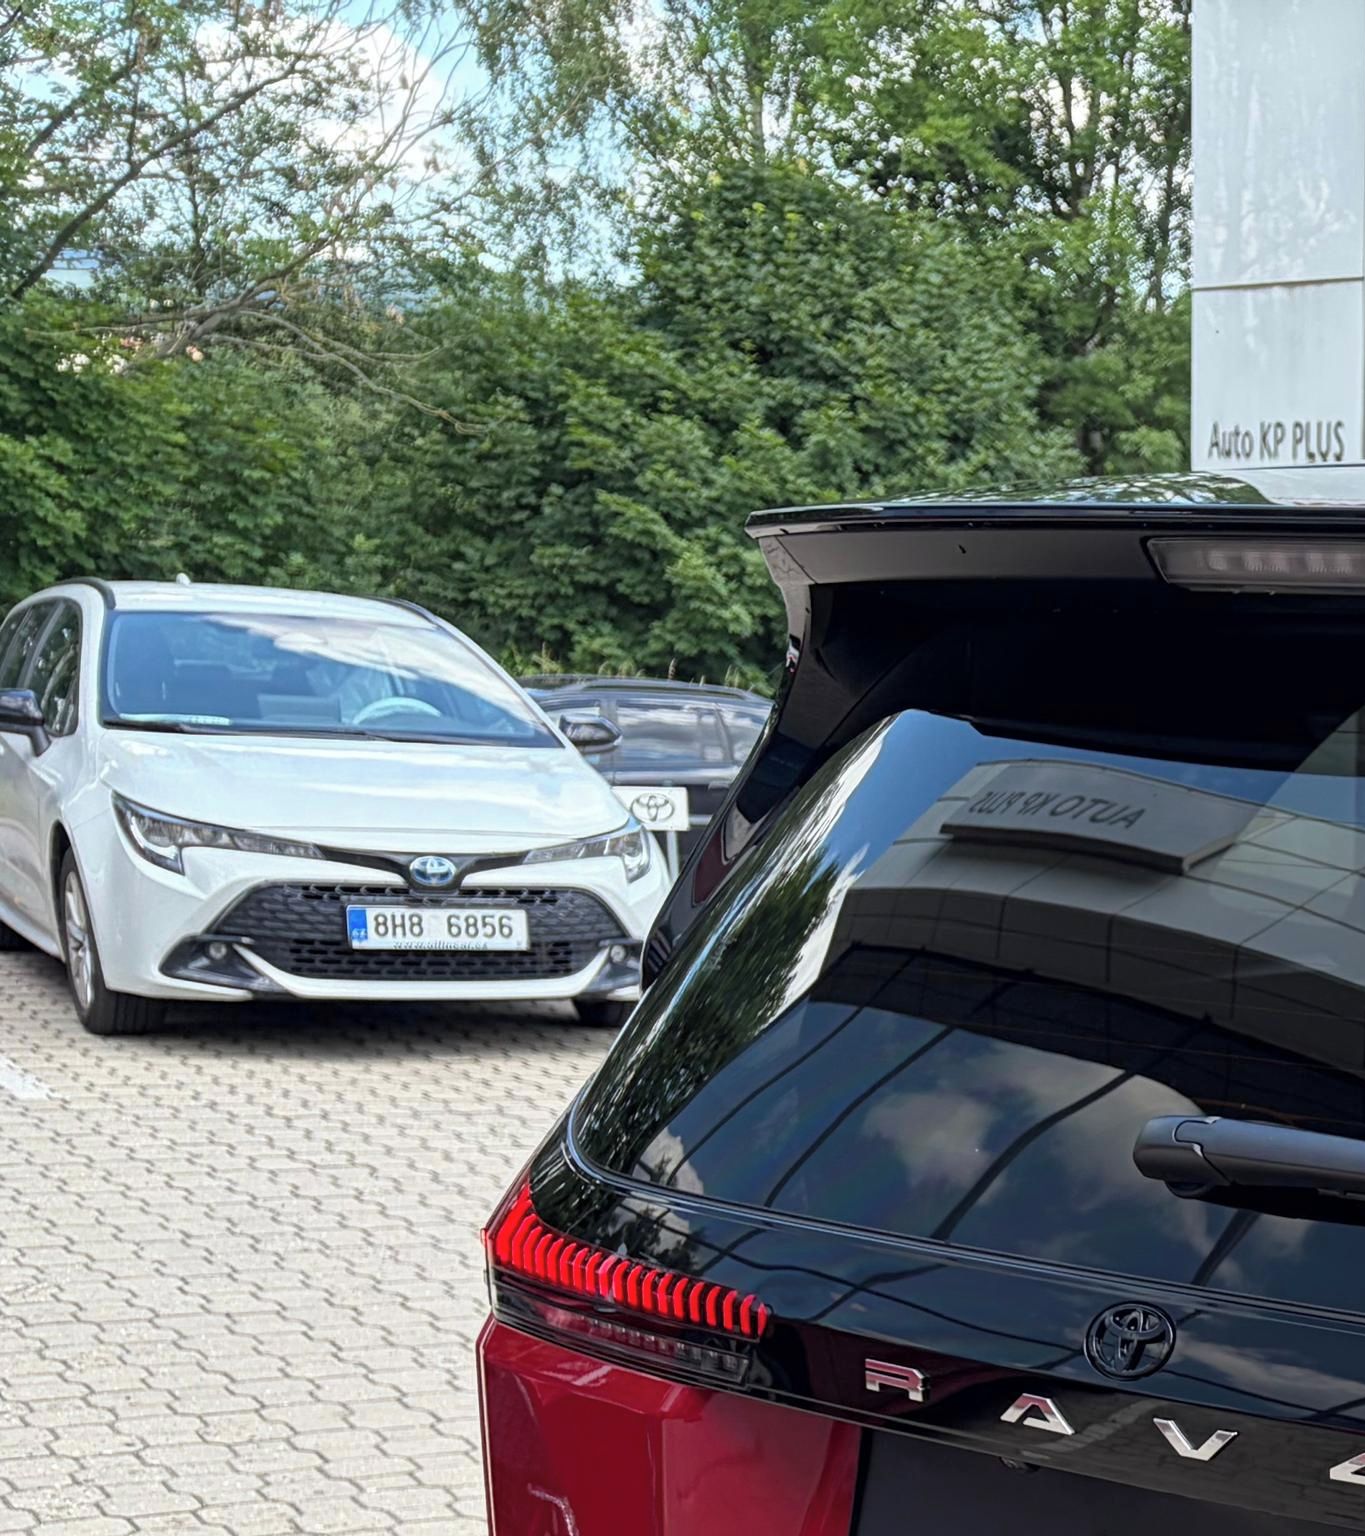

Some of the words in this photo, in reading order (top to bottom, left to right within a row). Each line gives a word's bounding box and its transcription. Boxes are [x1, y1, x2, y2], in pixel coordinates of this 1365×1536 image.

[1208, 421, 1253, 460] Auto
[1259, 421, 1286, 460] KP
[1292, 421, 1345, 461] PLUS
[373, 913, 424, 938] 8H8
[446, 914, 513, 939] 6856
